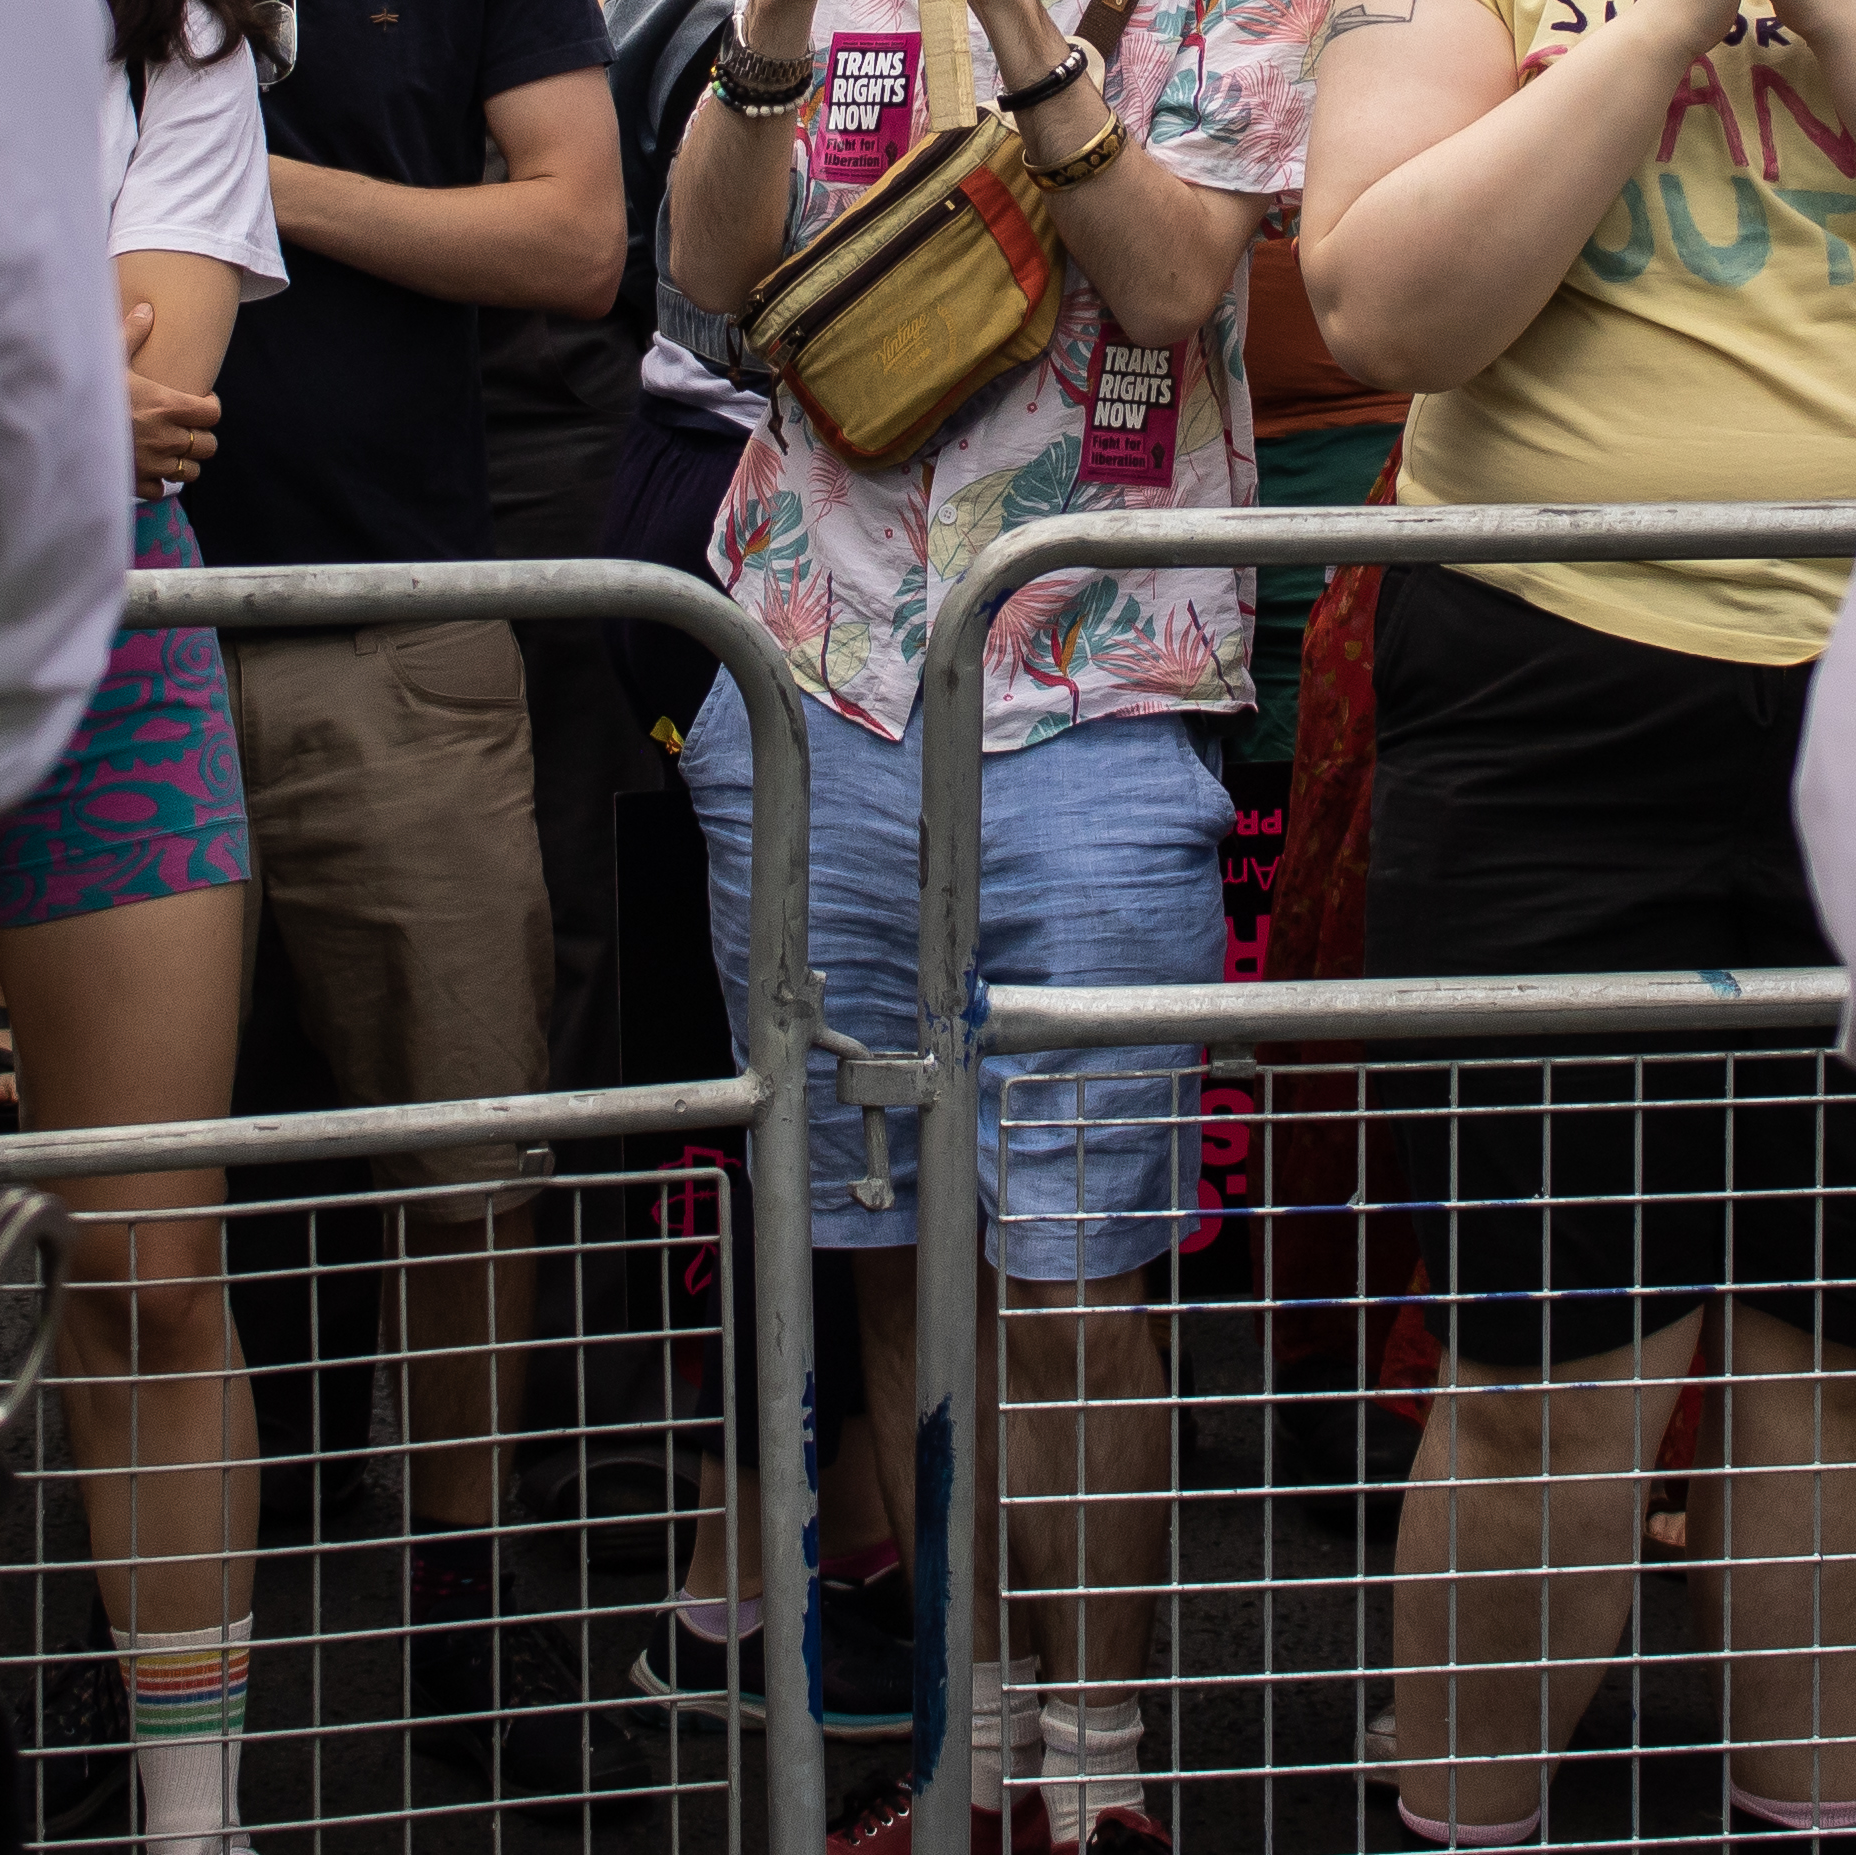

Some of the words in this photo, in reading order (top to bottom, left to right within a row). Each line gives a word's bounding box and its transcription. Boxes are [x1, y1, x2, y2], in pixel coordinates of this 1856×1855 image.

[836, 51, 904, 76] TRANS
[832, 78, 905, 103] RIGHTS
[829, 105, 880, 130] NOW
[826, 138, 856, 152] Fight
[860, 139, 875, 151] for
[824, 153, 880, 167] liberation
[1105, 345, 1169, 375] TRANS
[1099, 373, 1171, 404] RIGHTS
[1094, 401, 1146, 430] NOW
[1093, 435, 1120, 450] Fight
[1125, 437, 1142, 449] for
[1091, 452, 1145, 467] liberation
